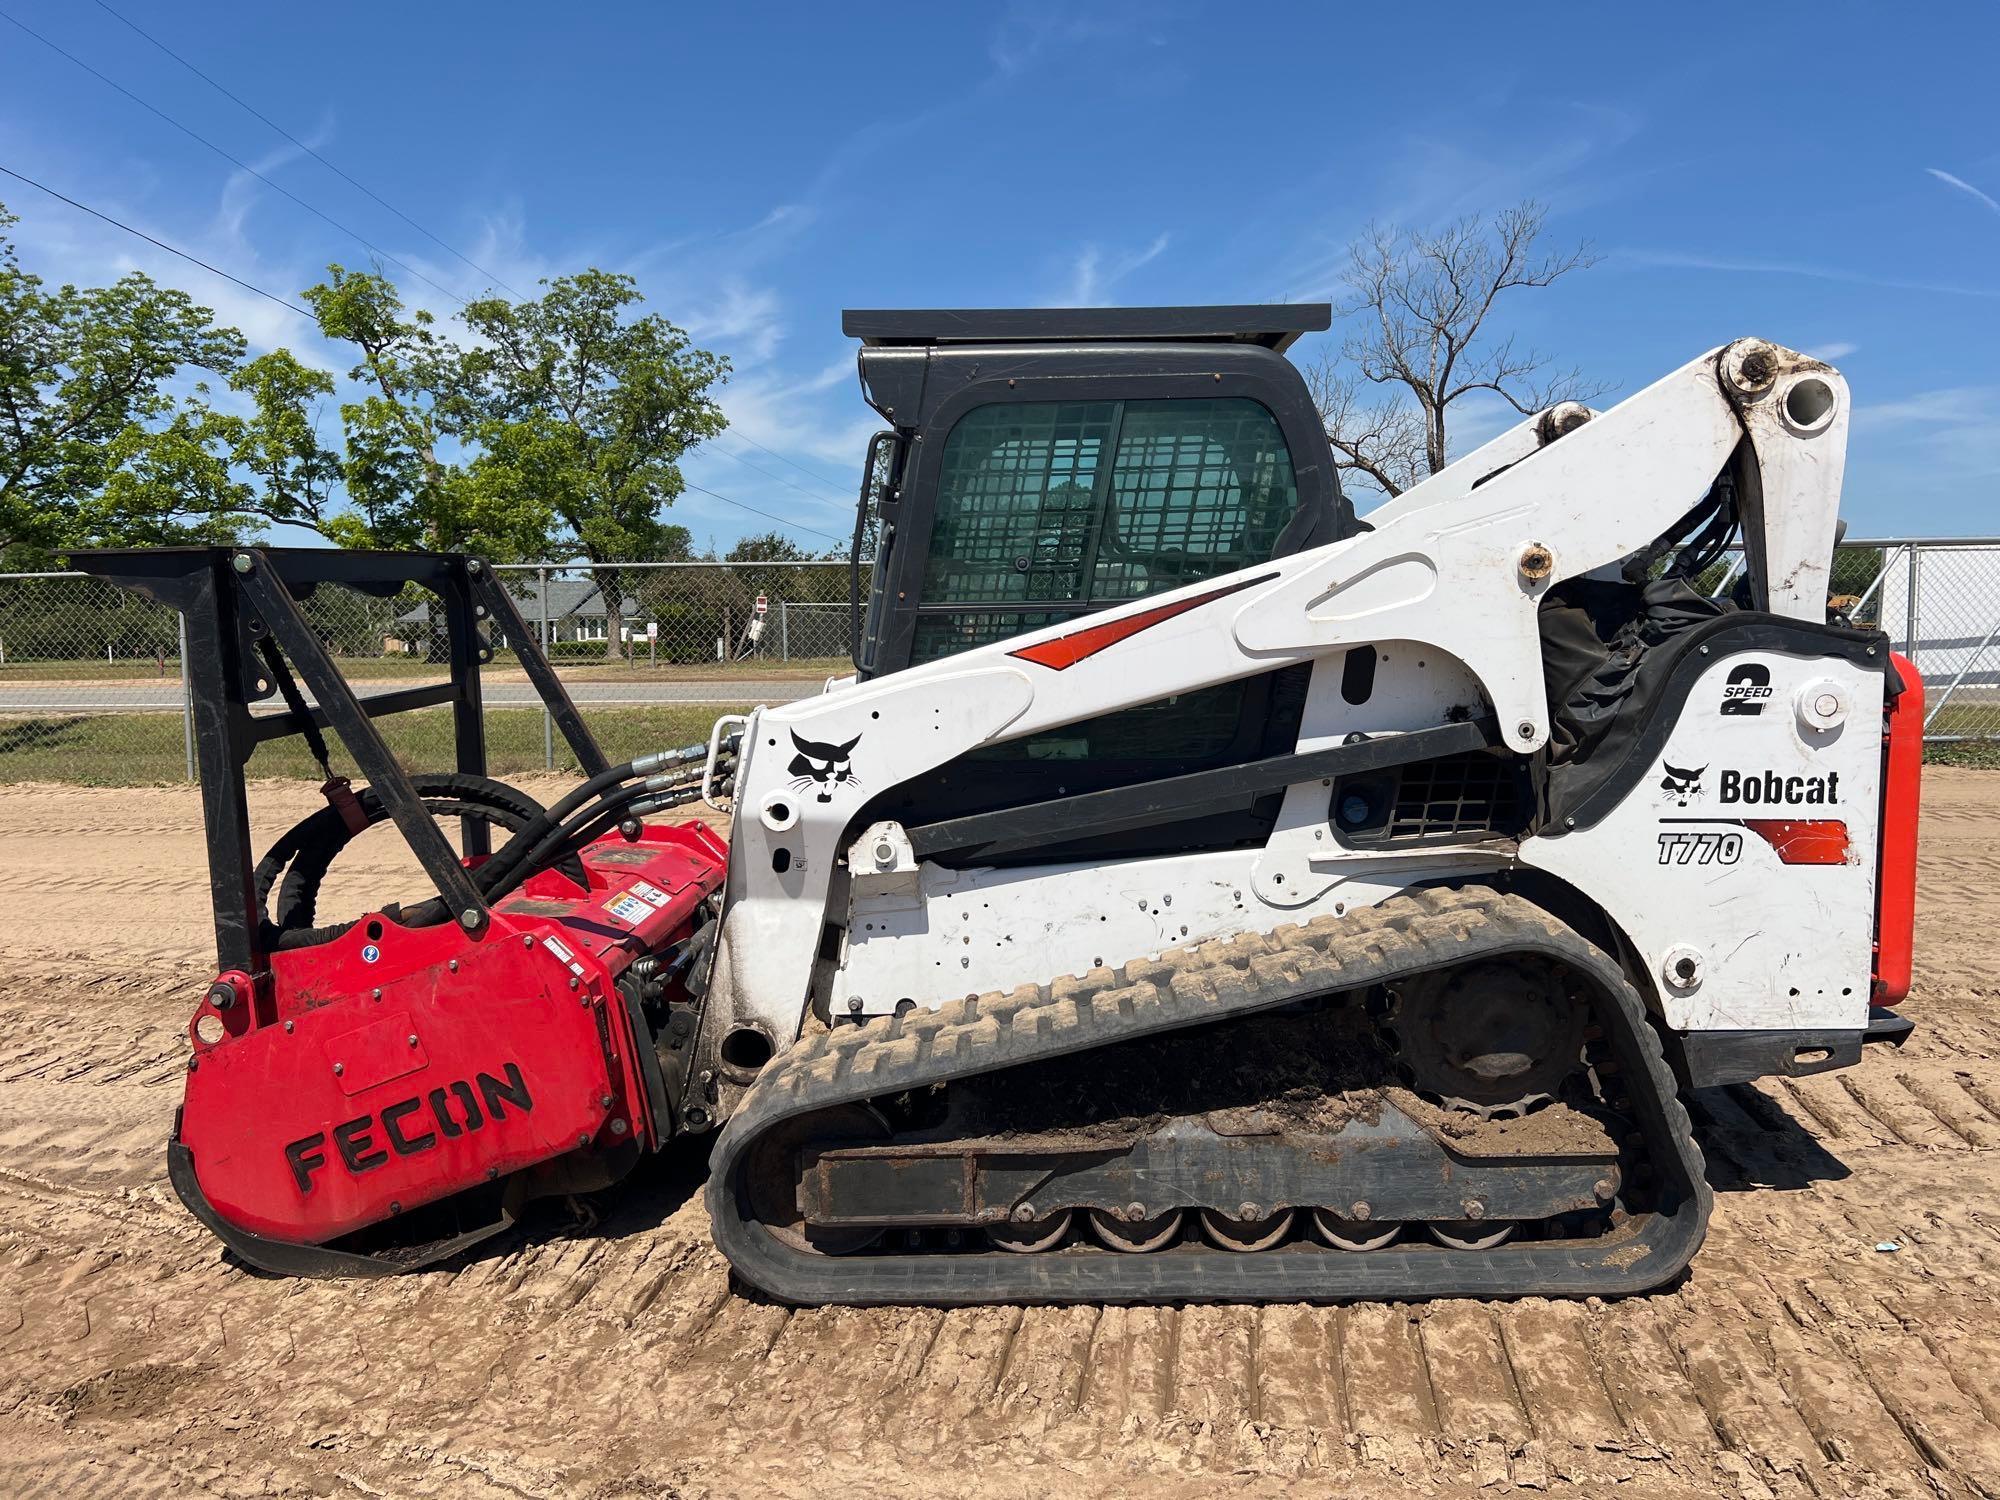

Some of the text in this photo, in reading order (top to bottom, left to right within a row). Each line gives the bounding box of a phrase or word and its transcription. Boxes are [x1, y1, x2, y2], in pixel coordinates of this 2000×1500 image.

[1720, 663, 1770, 715] 2
[1723, 687, 1773, 698] SPEED
[1720, 770, 1839, 804] Bobcat
[1658, 833, 1743, 865] T770
[285, 1062, 533, 1194] FECON
